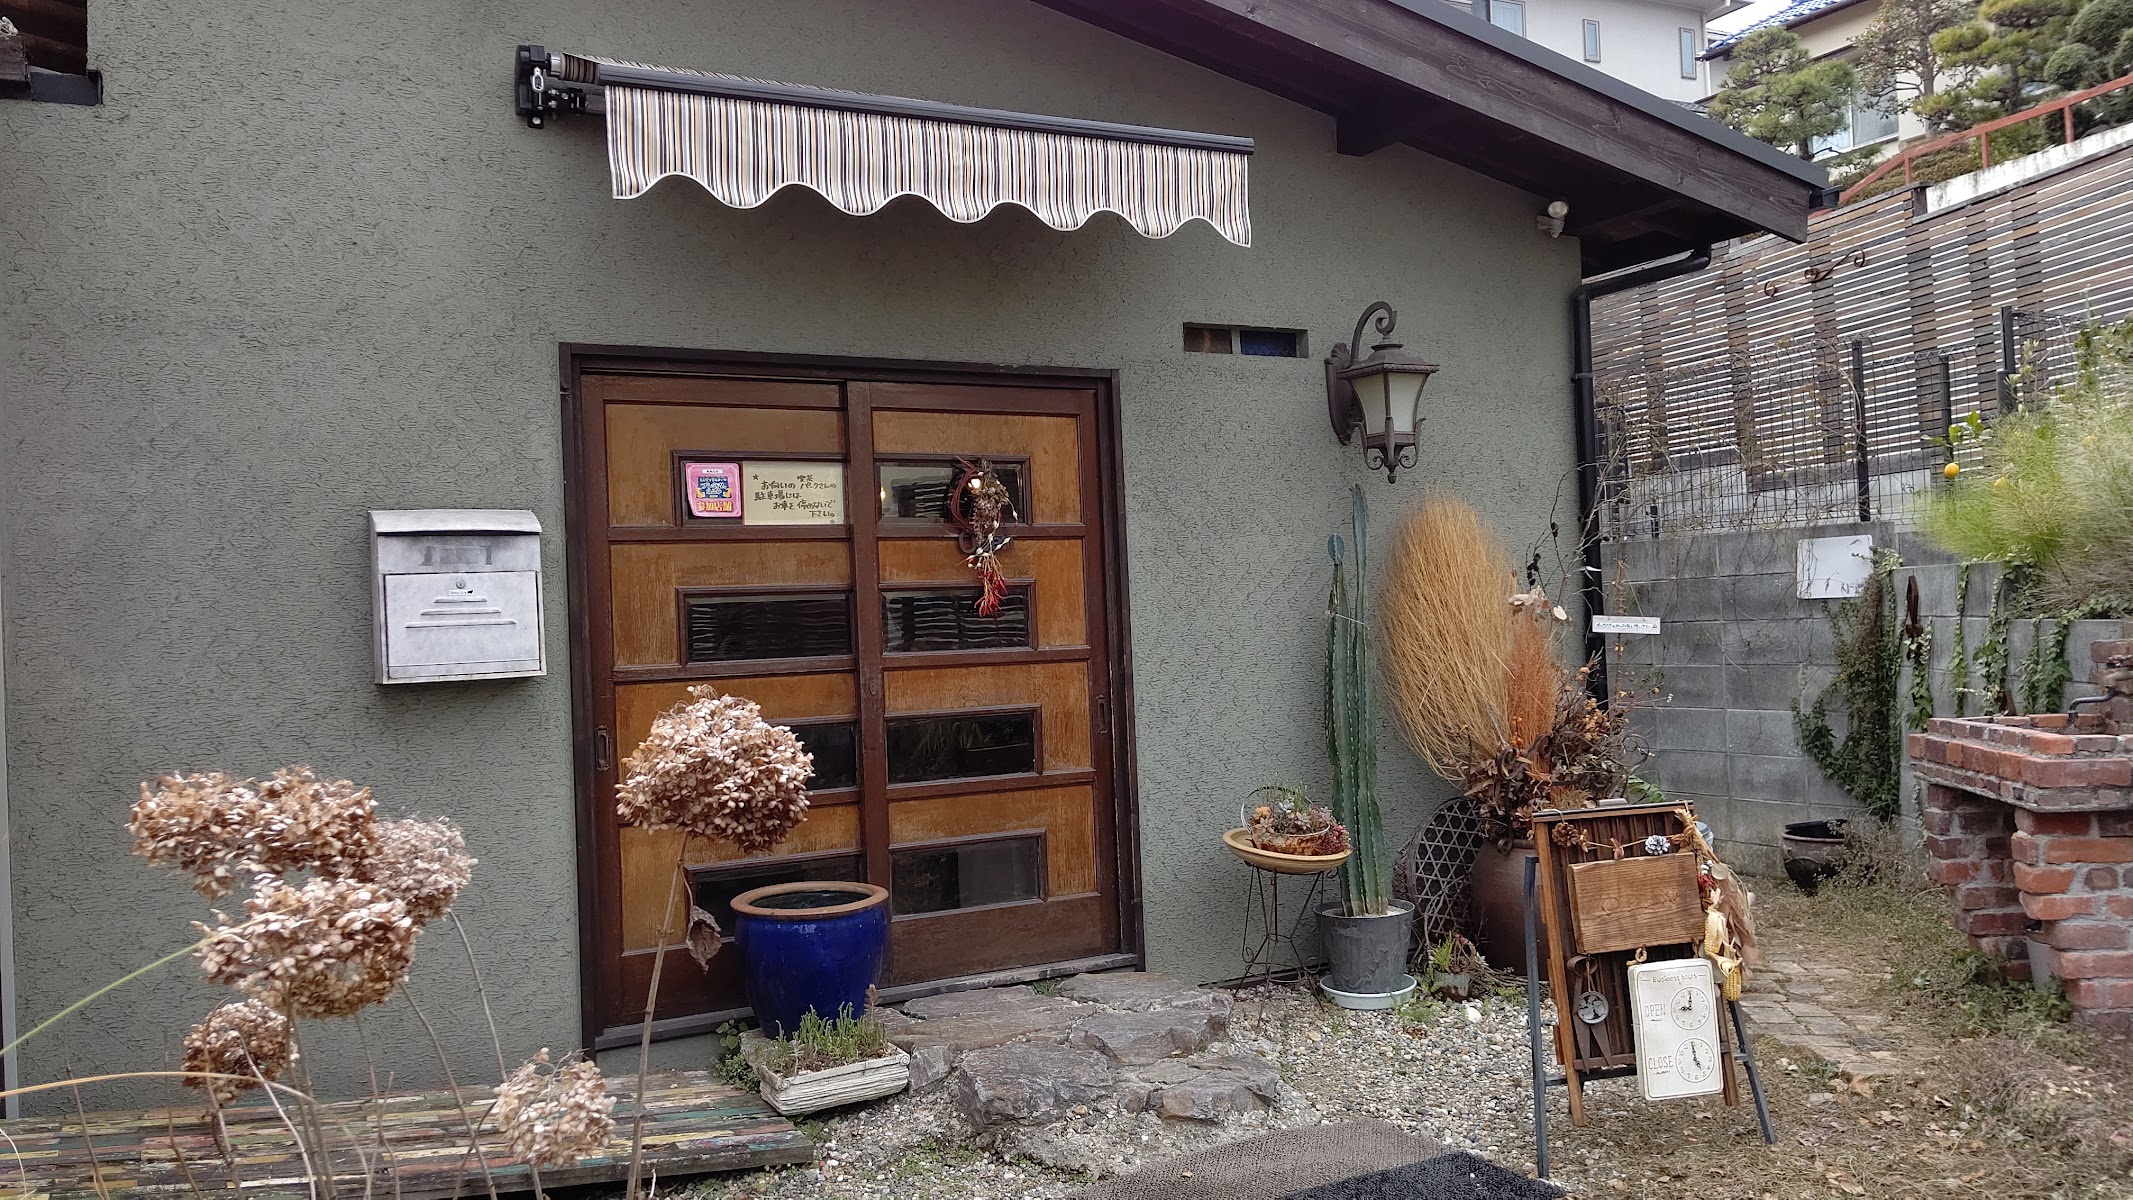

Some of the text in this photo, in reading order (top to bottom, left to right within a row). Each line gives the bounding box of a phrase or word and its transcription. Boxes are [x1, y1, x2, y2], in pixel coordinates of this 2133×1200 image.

[754, 490, 802, 502] 駐車場には
[697, 501, 733, 512] 参加店舗
[1645, 1003, 1666, 1017] OPEN
[1648, 1055, 1673, 1070] CLOSE
